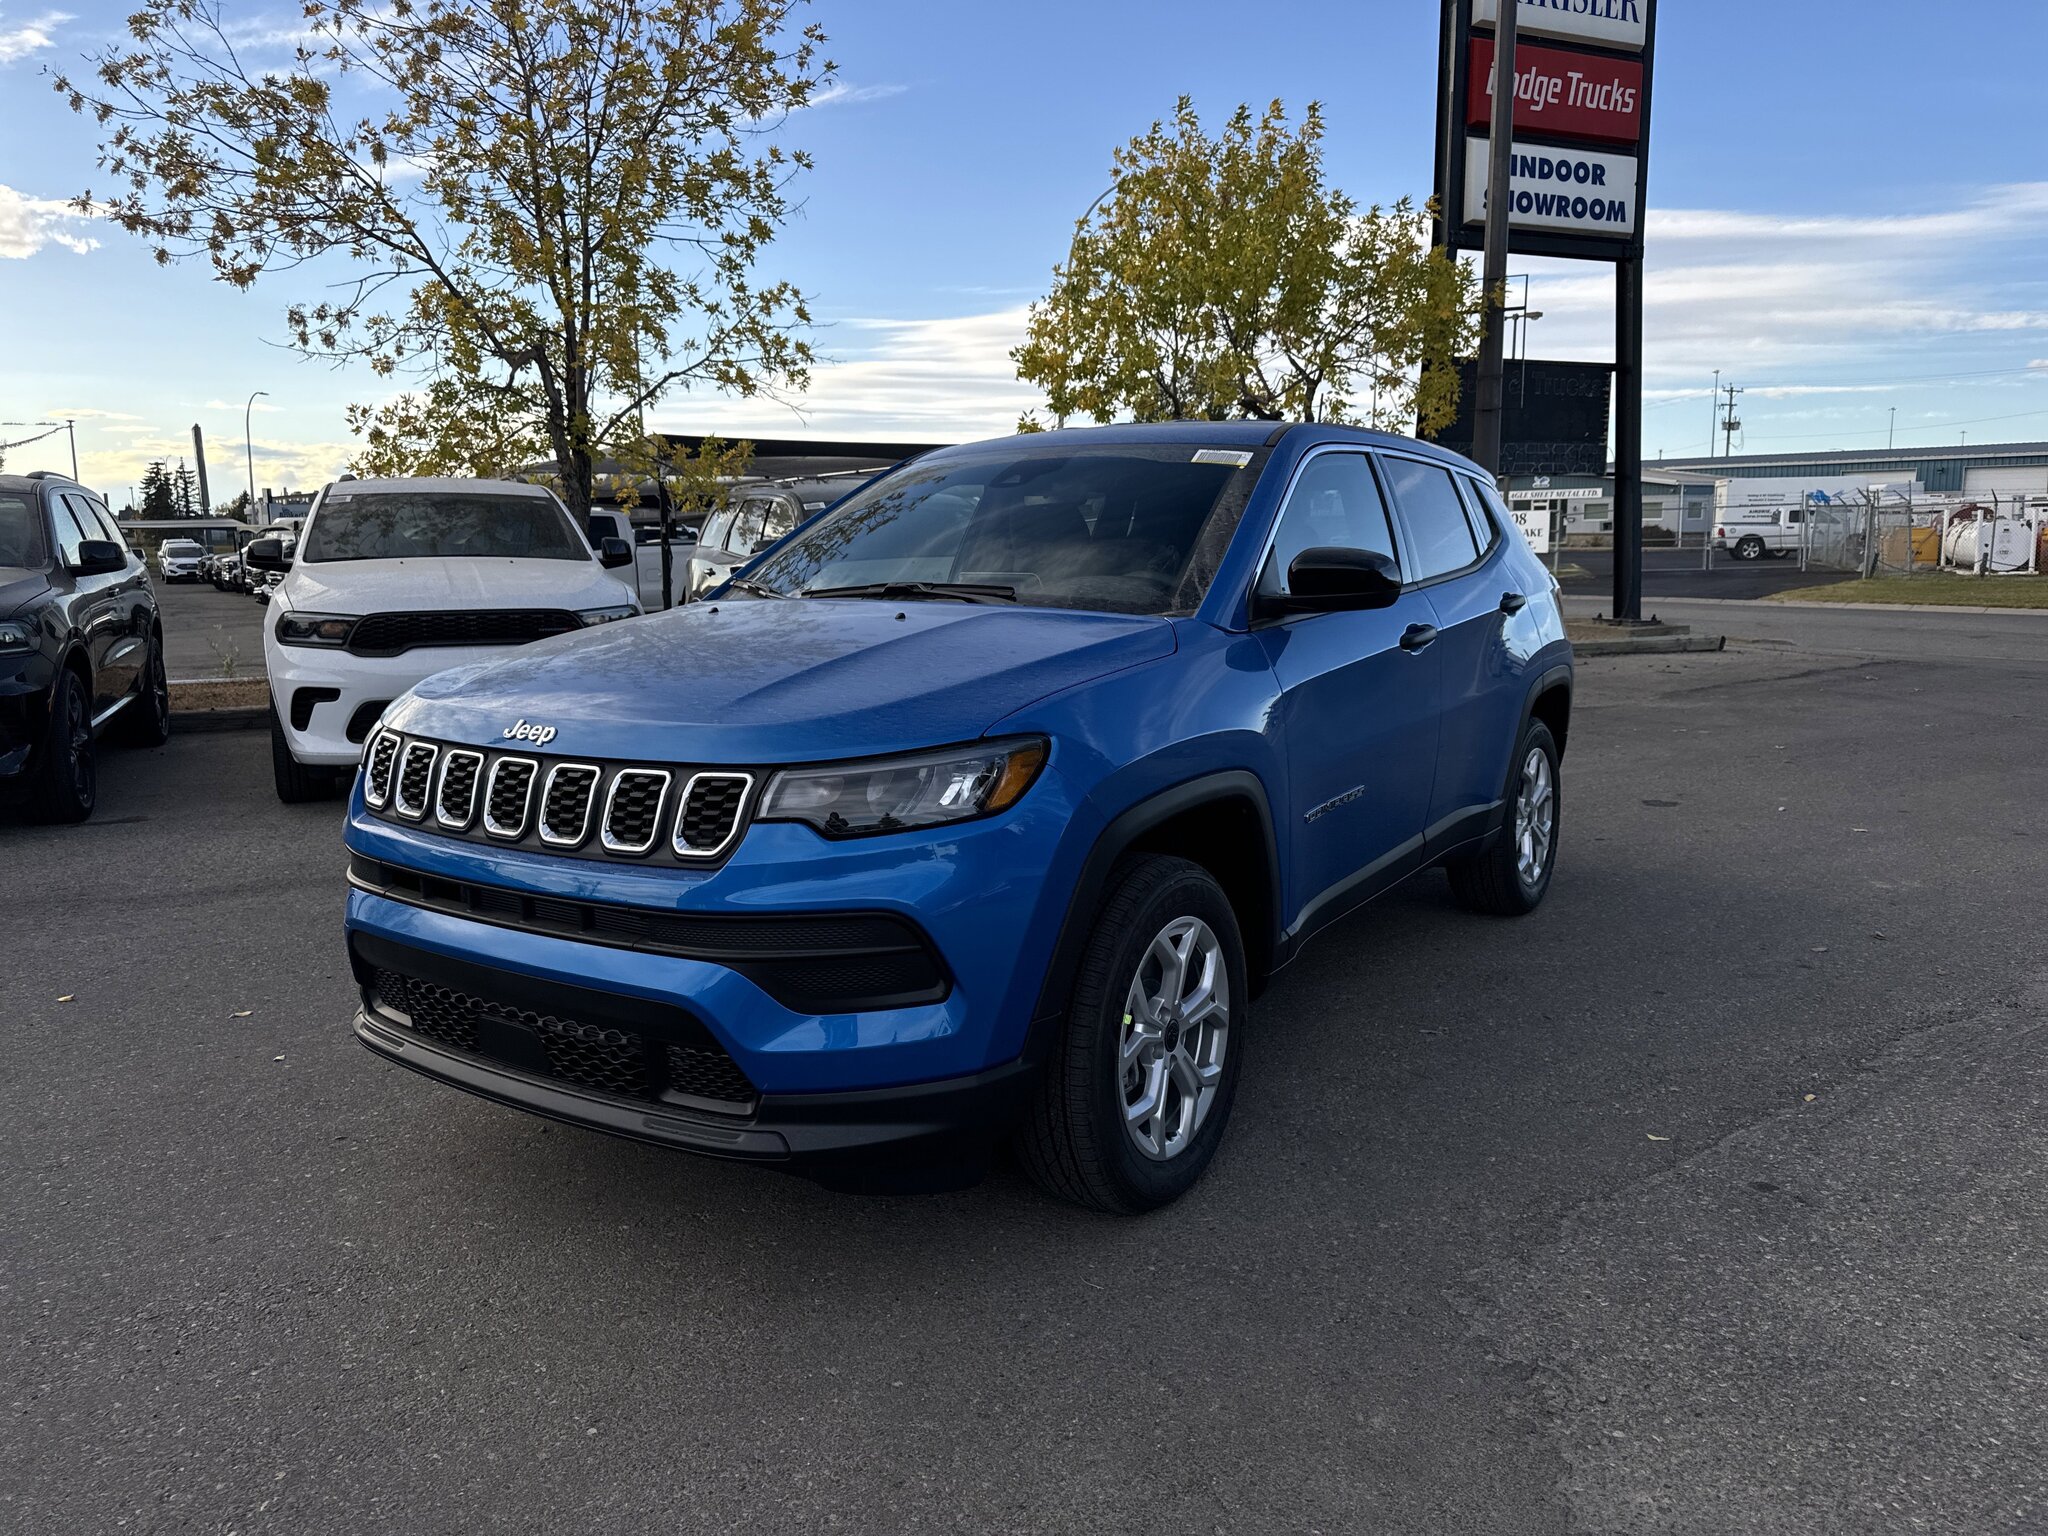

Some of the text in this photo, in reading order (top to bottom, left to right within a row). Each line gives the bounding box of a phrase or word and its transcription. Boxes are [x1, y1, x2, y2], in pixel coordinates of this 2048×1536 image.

[1517, 0, 1640, 23] SLER
[1567, 71, 1636, 113] Trucks
[1510, 154, 1606, 186] INDOOR
[1483, 188, 1627, 222] OWROOM
[1510, 492, 1529, 500] AGLE
[1530, 491, 1554, 499] SHEET
[1556, 490, 1581, 498] METAL
[1523, 528, 1543, 538] AKE
[503, 719, 556, 747] Jeep
